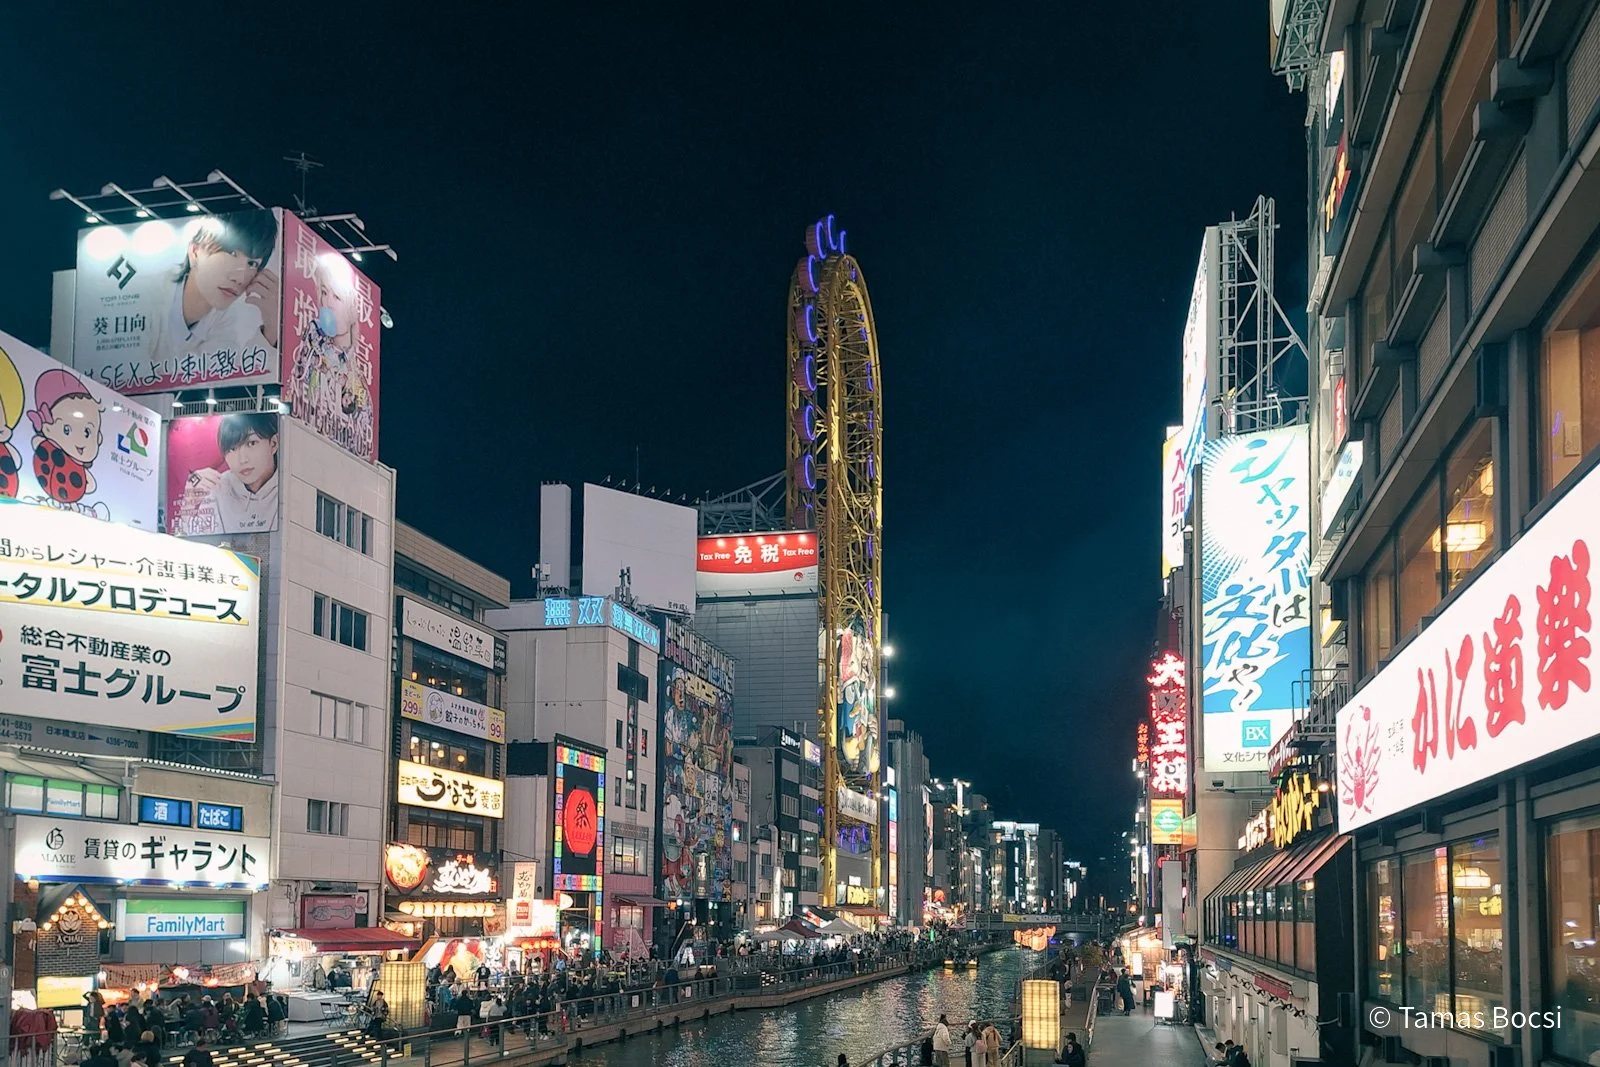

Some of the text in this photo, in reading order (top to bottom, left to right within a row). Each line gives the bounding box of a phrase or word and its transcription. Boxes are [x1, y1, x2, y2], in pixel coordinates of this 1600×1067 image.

[700, 544, 815, 564] Tax Free 免税 Tax Free
[20, 624, 172, 666] 総合不動産業の
[21, 654, 246, 714] 富士グループ
[1245, 726, 1268, 740] BX
[47, 797, 80, 807] FamilyMart
[154, 801, 168, 821] 酒
[200, 807, 230, 826] たばこ
[84, 835, 256, 874] 賃貸のギャラント
[147, 916, 225, 934] FamilyMart
